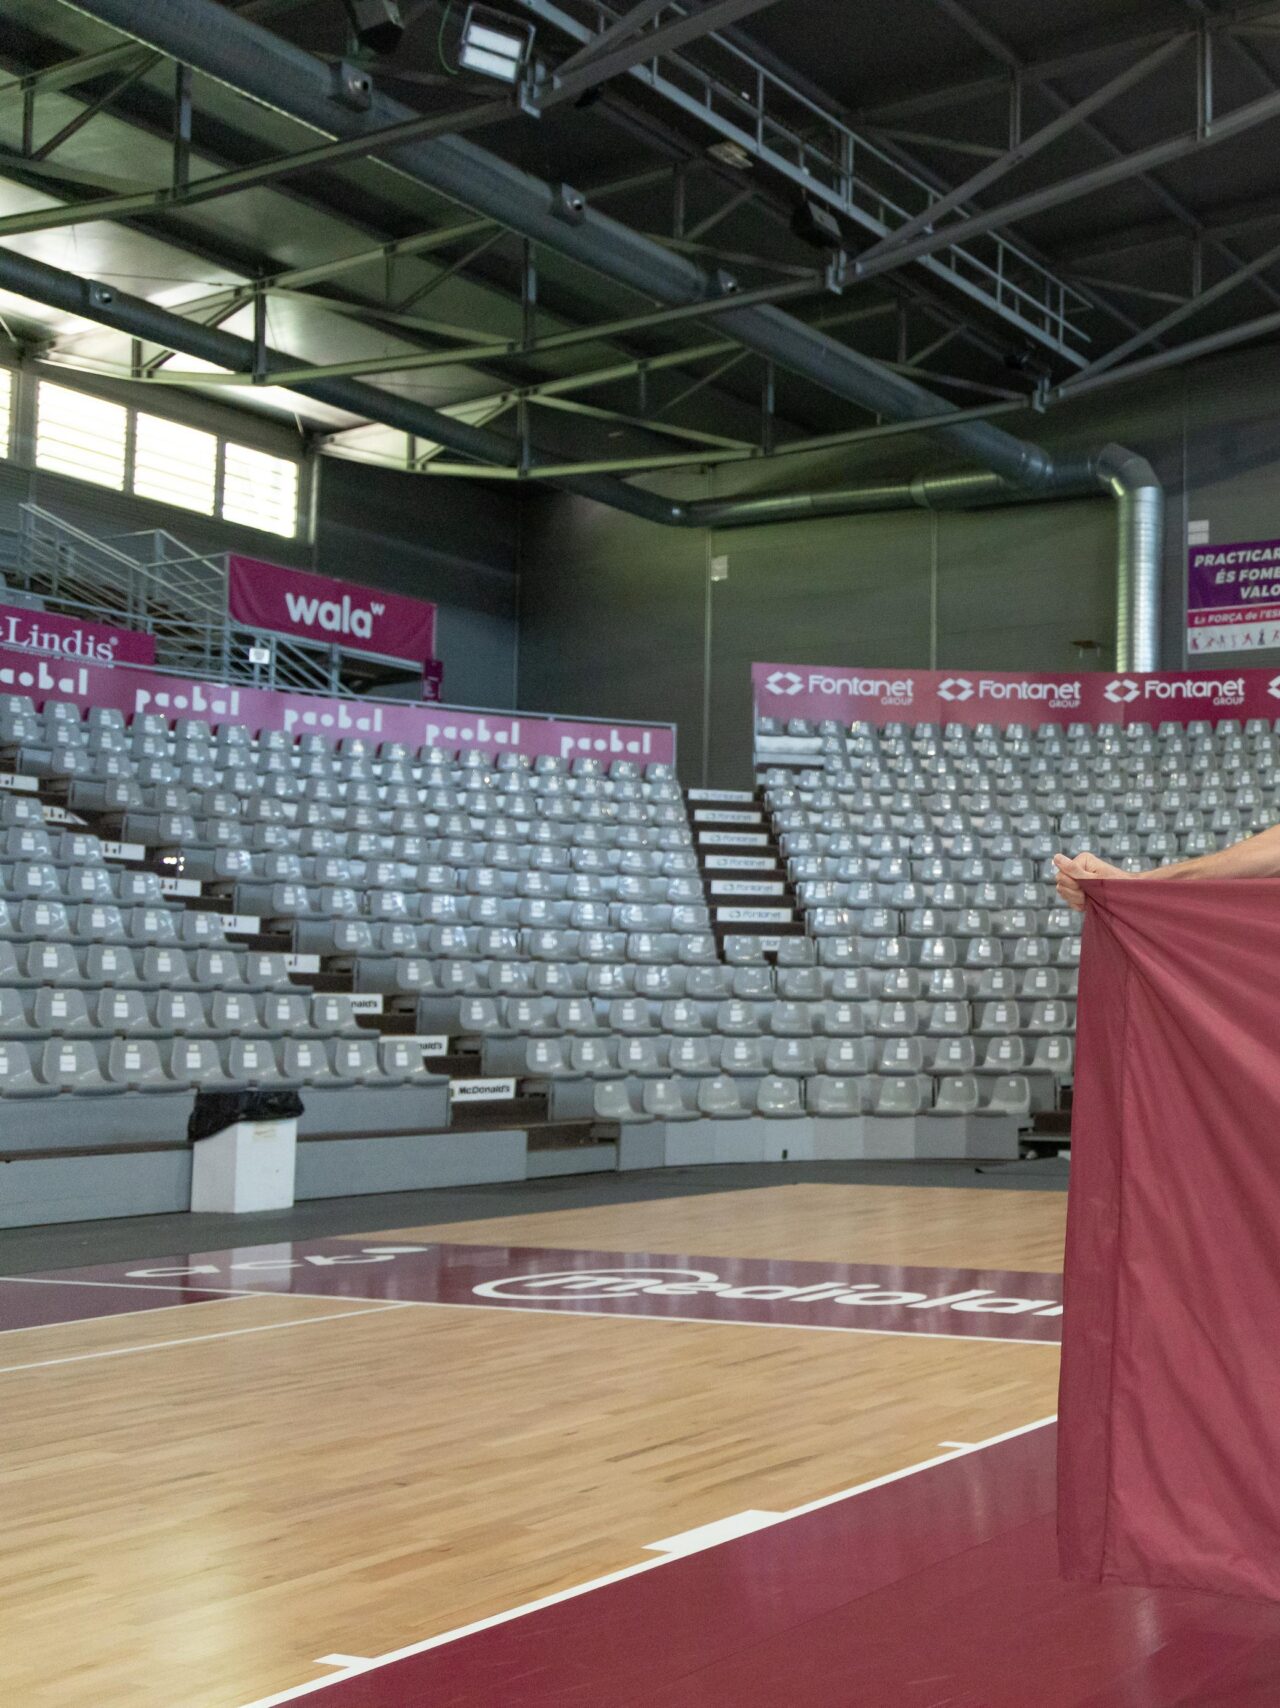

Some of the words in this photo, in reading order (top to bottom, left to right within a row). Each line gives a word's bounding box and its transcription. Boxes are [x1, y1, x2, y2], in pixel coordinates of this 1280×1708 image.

[1215, 566, 1237, 584] ÉS
[286, 592, 373, 640] wala
[1207, 612, 1243, 624] FORÇA
[0, 615, 115, 661] Lindis
[0, 662, 88, 695] aobal
[808, 675, 914, 698] Fontanet
[1144, 678, 1245, 699] Fontanet
[136, 686, 240, 714] paobal
[881, 696, 914, 706] GROUP
[978, 680, 1082, 700] Fontanet
[1049, 699, 1082, 708] GROUP
[1213, 697, 1245, 706] GROUP
[284, 704, 383, 732] paobal
[426, 719, 520, 746] paobal
[561, 729, 651, 759] paobal
[458, 1085, 511, 1095] McDonald's
